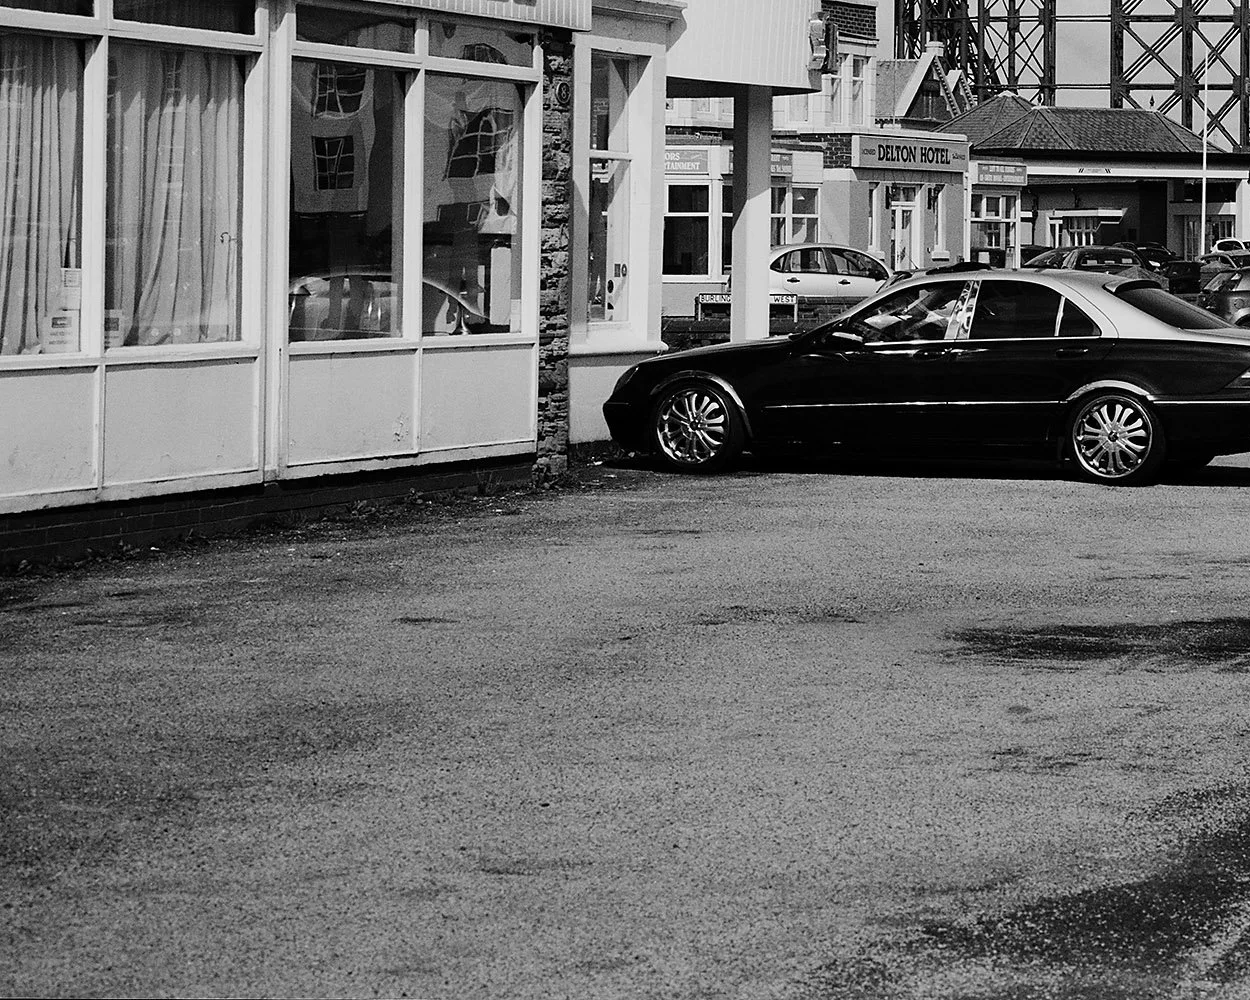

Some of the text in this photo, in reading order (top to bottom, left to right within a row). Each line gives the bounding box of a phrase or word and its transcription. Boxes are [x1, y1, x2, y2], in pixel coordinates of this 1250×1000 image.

[561, 85, 567, 98] 8
[665, 152, 680, 161] ORS
[878, 144, 916, 162] DELTON
[921, 147, 950, 164] HOTEL
[665, 162, 700, 170] TAINMENT
[700, 294, 796, 303] BURLING WEST
